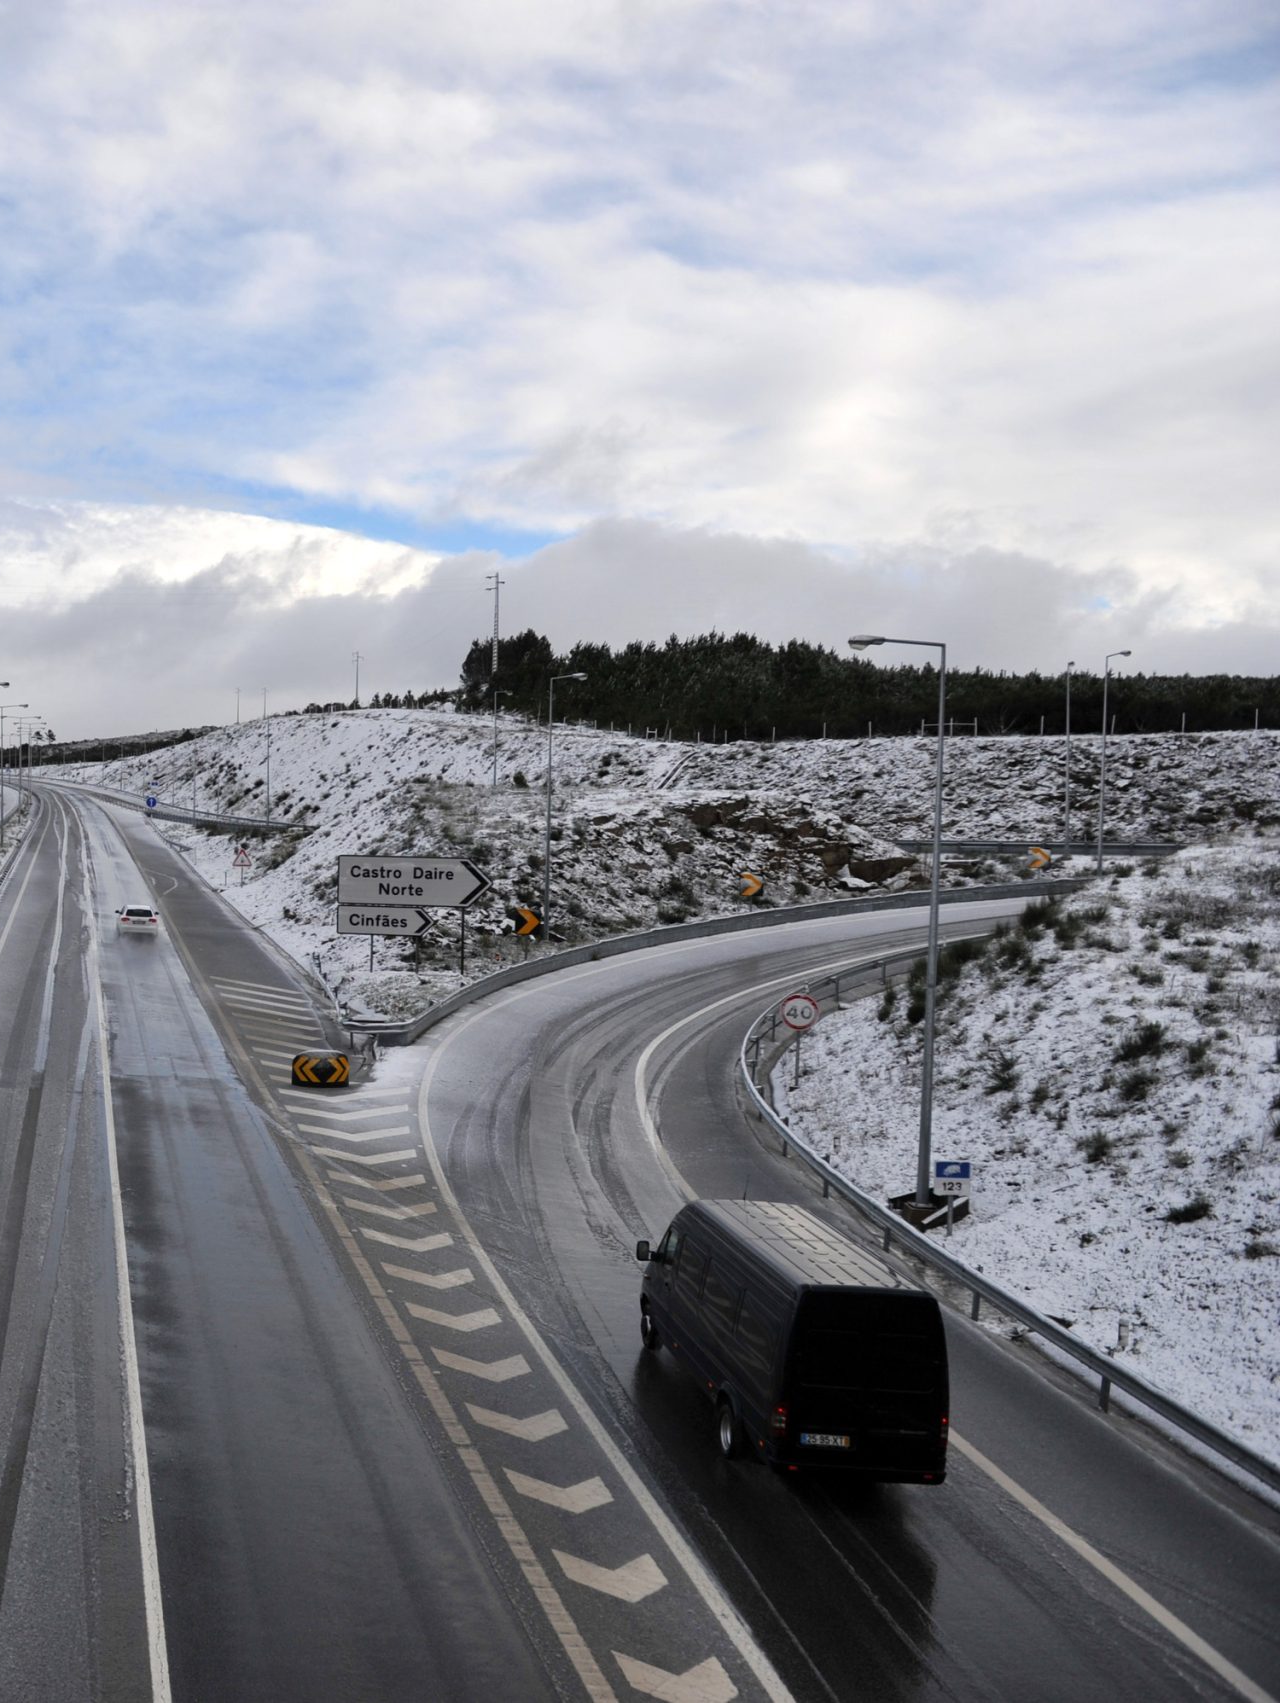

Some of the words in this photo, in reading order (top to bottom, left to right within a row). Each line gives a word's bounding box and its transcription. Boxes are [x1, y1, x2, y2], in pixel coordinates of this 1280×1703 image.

[350, 865, 402, 879] Castro
[413, 867, 454, 880] Daire
[378, 883, 424, 896] Norte
[349, 913, 408, 928] Cinfães
[786, 1006, 813, 1019] 40
[942, 1182, 962, 1191] 123
